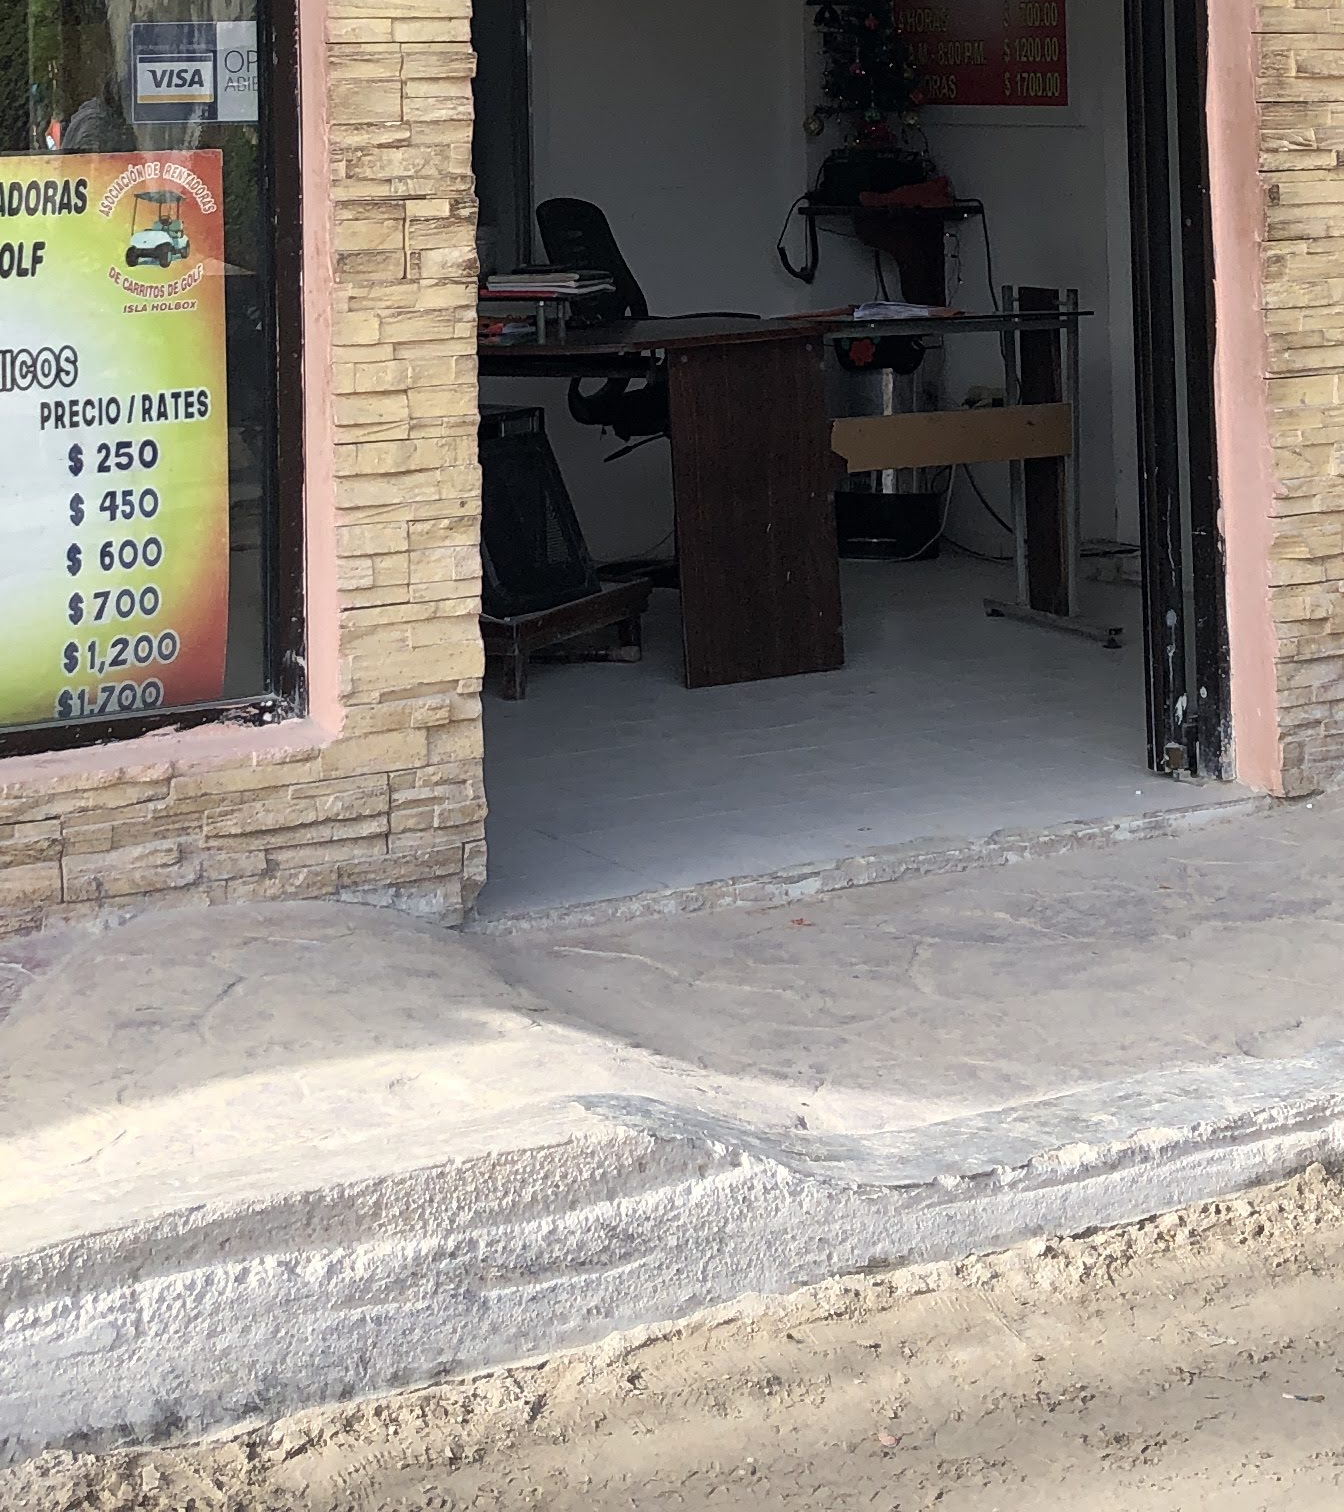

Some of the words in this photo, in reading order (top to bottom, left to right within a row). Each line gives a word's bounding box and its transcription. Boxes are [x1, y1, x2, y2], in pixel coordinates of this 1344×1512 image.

[1014, 37, 1060, 62] 1200.00
[146, 68, 204, 89] VISA
[923, 74, 958, 99] ORAS
[1015, 71, 1061, 97] 1700.00
[99, 164, 145, 218] ASOCIACIÓN
[145, 162, 160, 178] DE
[163, 163, 217, 215] RENTADORAS
[109, 266, 121, 285] DE
[122, 276, 165, 299] CARRITOS
[167, 281, 180, 297] DE
[181, 263, 204, 292] GOLF
[123, 303, 148, 313] ISLA
[151, 300, 197, 312] HOLBOX
[40, 397, 121, 430] PRECIO
[141, 390, 209, 422] RATES
[68, 443, 84, 477] $
[96, 439, 159, 474] 250
[69, 492, 86, 527] $
[99, 488, 159, 522] 450
[66, 542, 82, 577] $
[99, 537, 163, 571] 600
